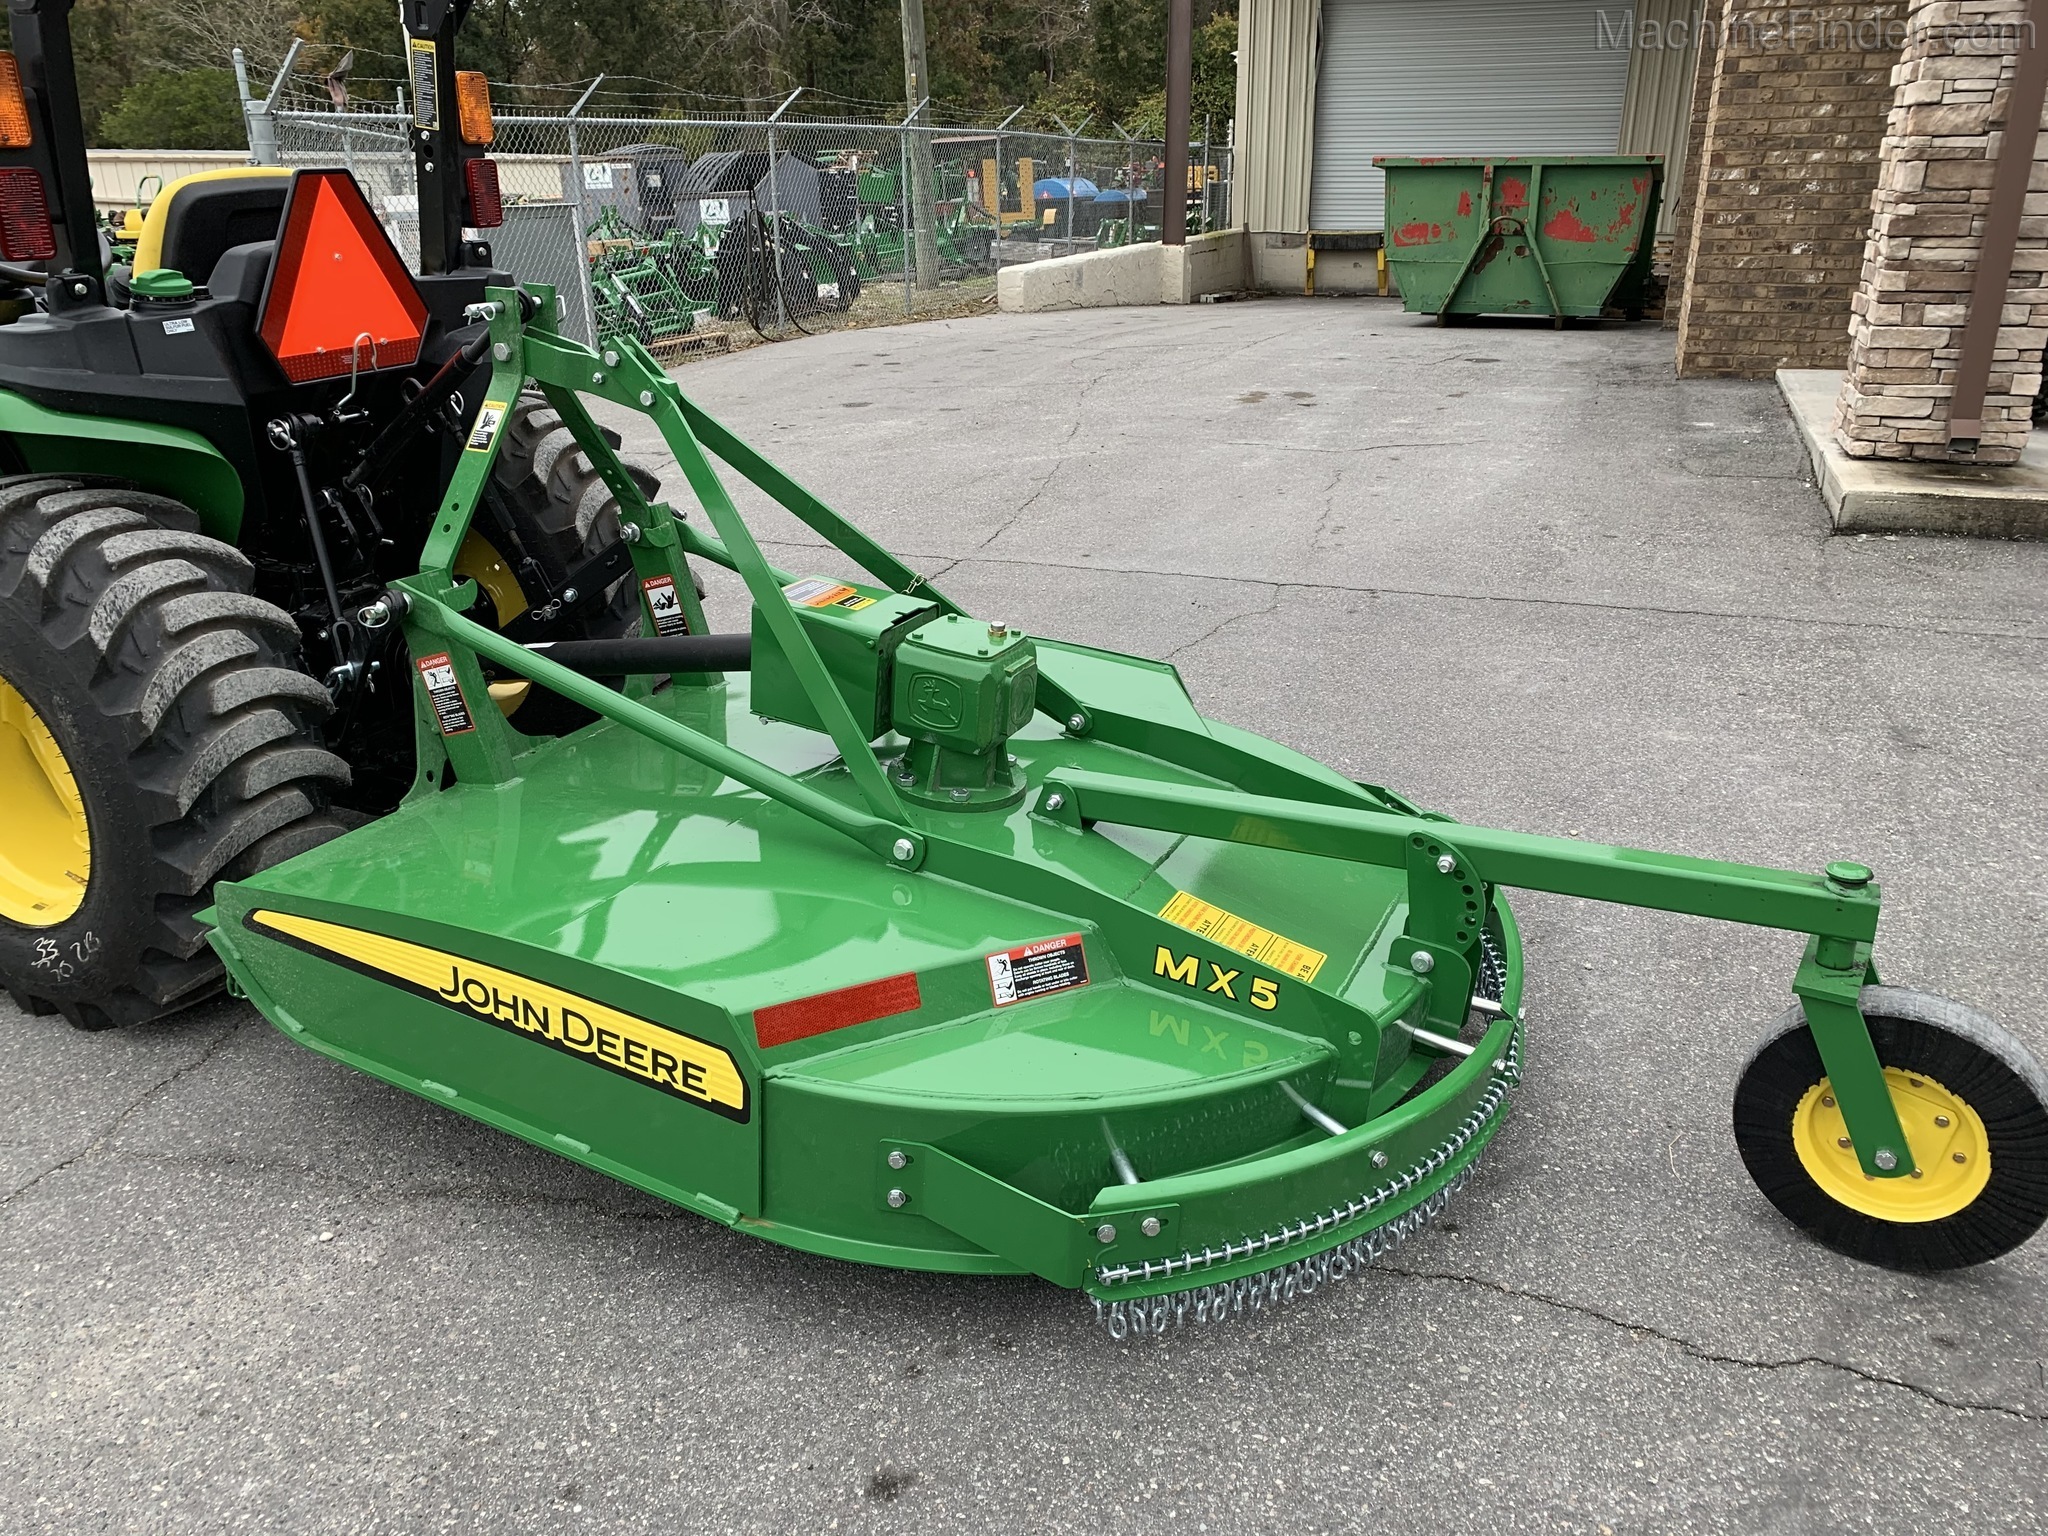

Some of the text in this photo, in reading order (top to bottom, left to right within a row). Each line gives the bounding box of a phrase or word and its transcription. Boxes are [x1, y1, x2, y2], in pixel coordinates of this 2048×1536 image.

[650, 576, 673, 587] DANGER
[425, 655, 448, 667] DANGER
[1033, 938, 1067, 954] DANGER
[440, 966, 708, 1096] JOHN DEERE
